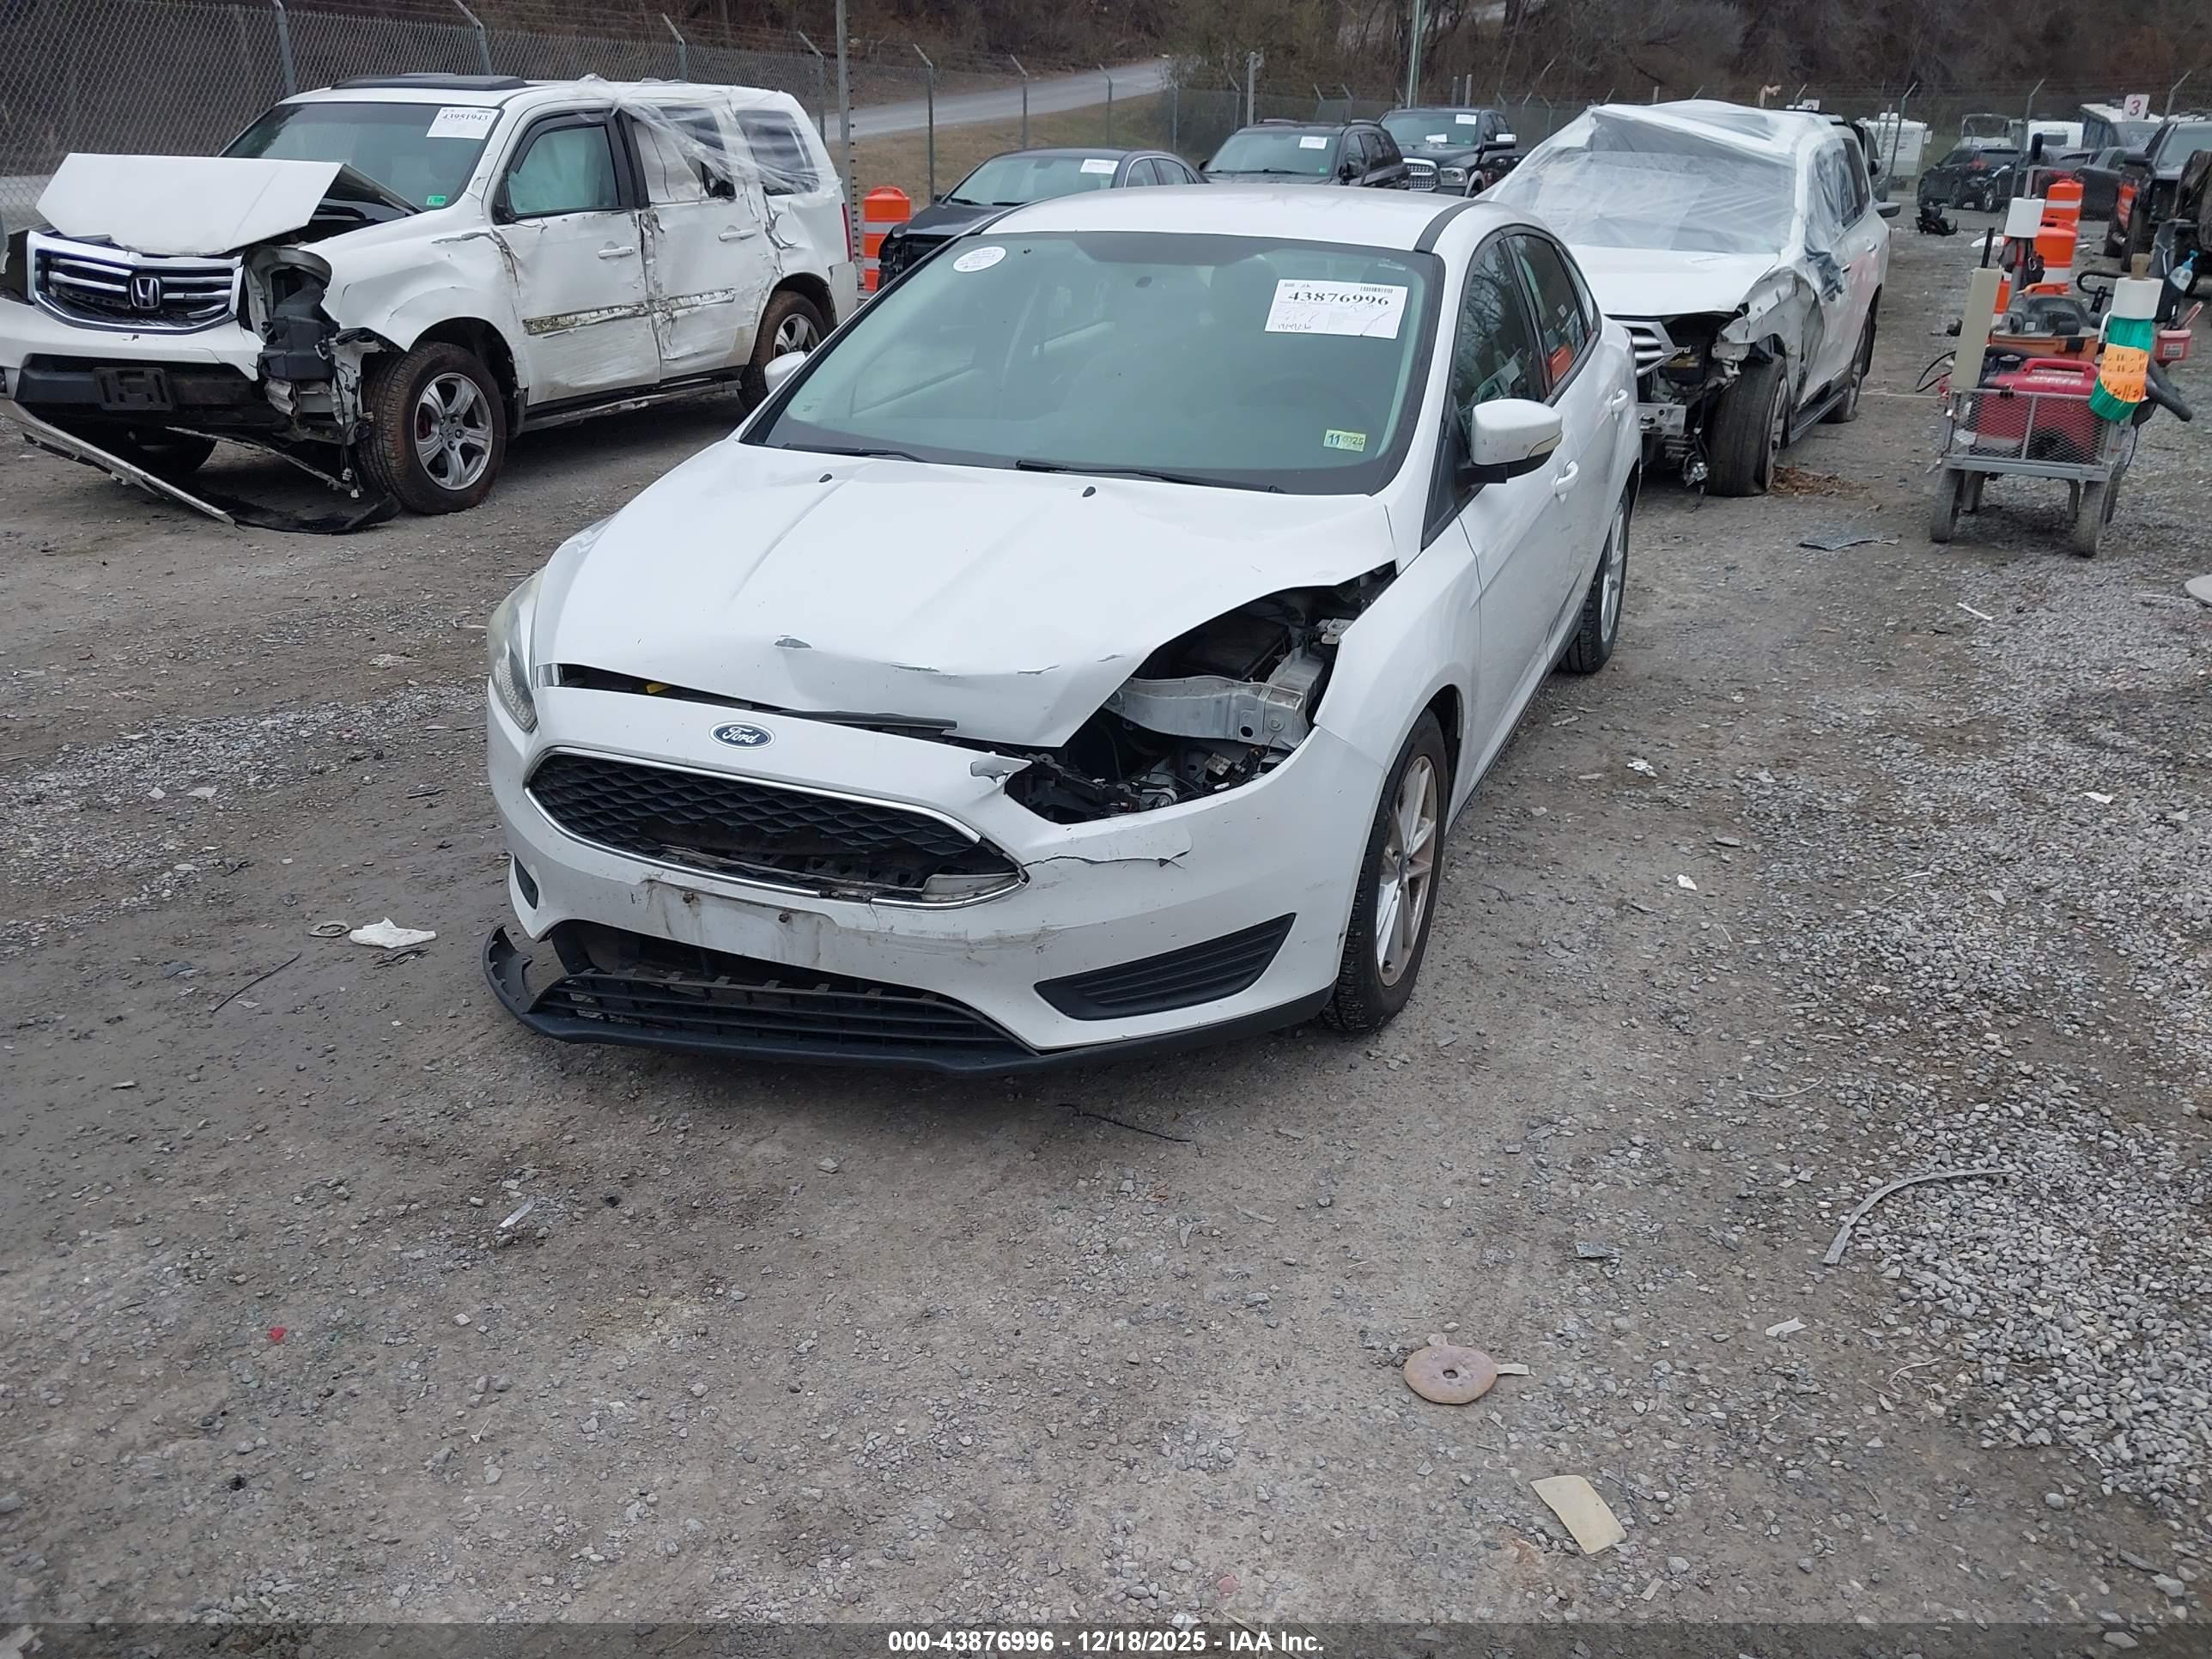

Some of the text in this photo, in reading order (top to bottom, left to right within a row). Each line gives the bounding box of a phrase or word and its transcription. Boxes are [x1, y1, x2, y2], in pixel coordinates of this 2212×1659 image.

[2129, 100, 2142, 117] 3
[1287, 291, 1389, 307] 43876996
[1328, 433, 1340, 445] 11
[722, 726, 761, 744] Ford
